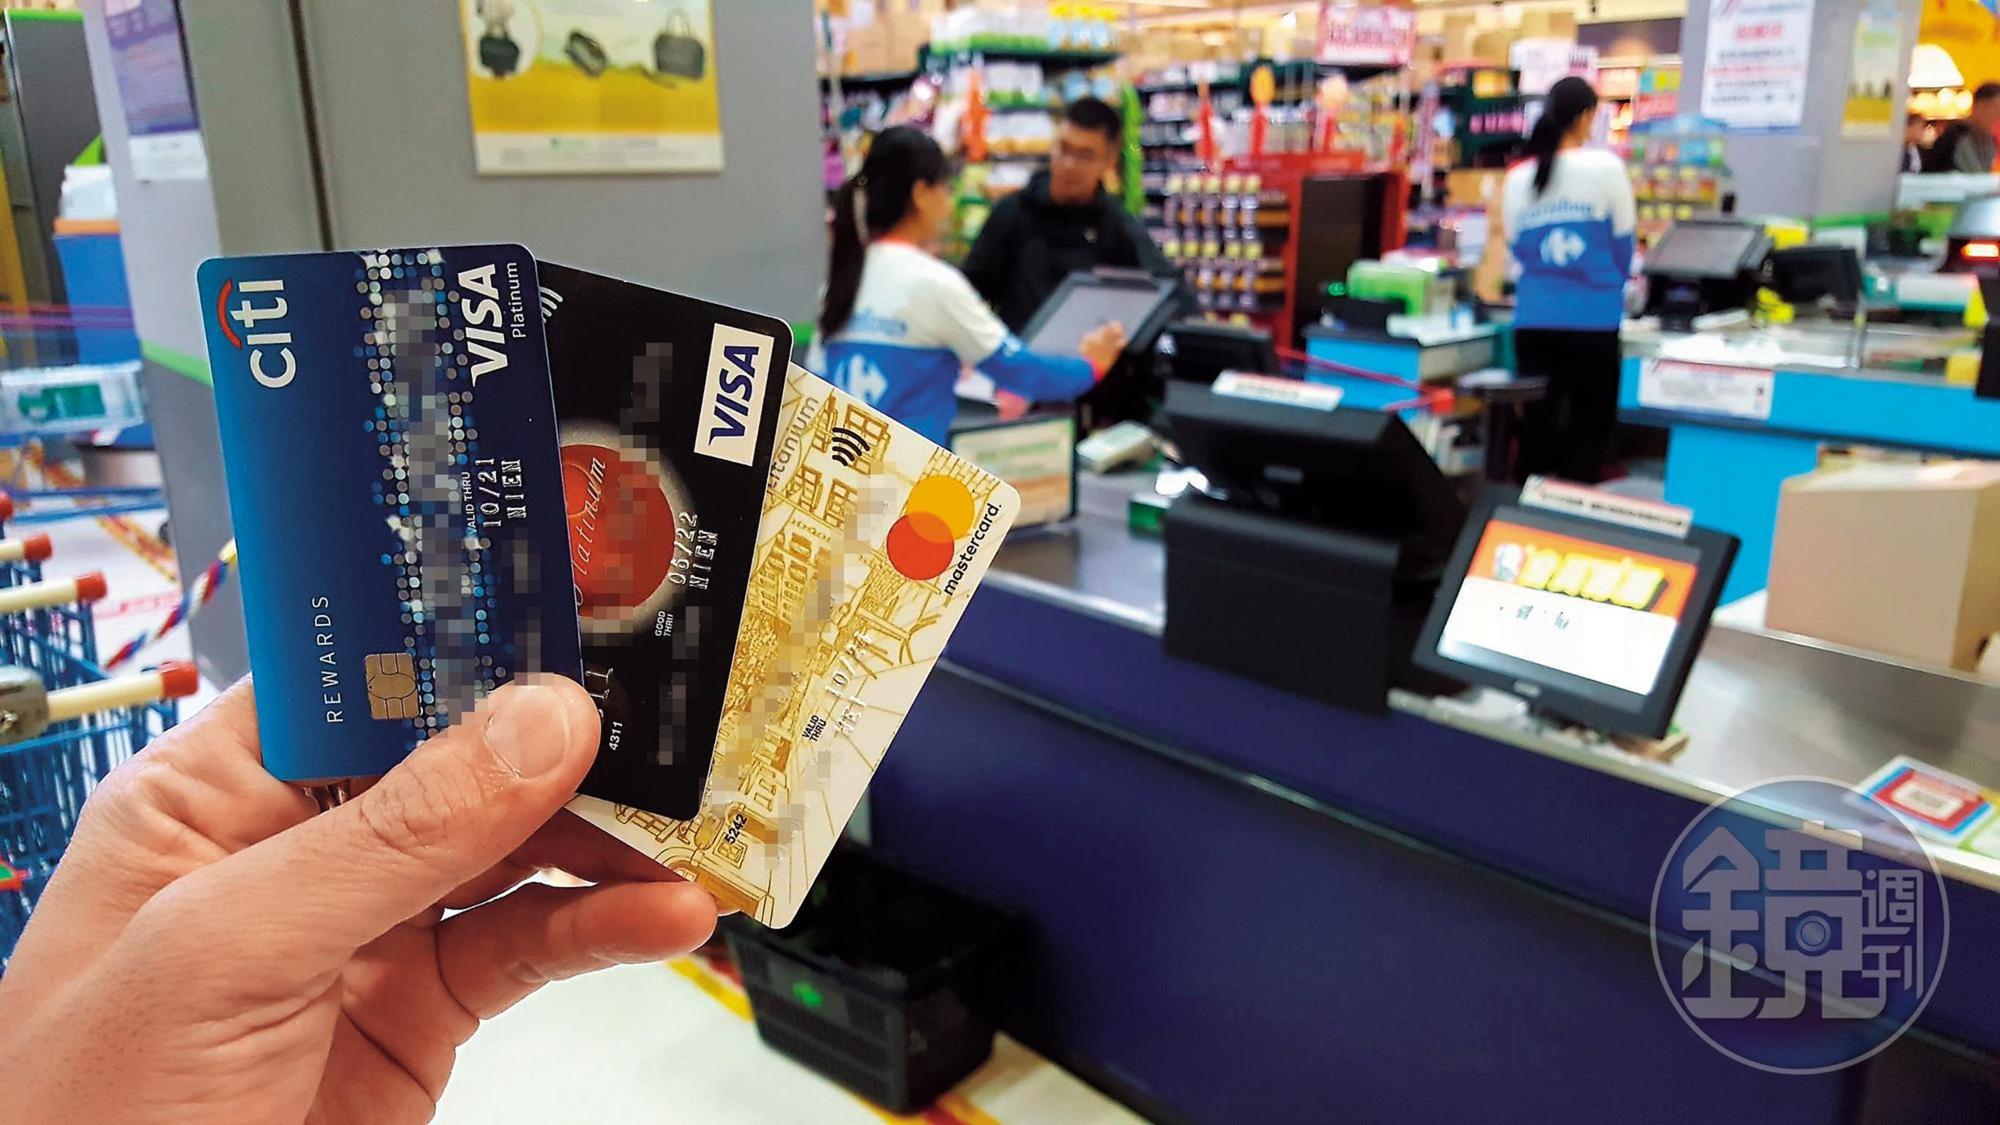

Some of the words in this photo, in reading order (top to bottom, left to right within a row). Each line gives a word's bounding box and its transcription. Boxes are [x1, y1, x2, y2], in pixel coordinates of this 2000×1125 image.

[505, 262, 527, 339] Platinum
[229, 279, 297, 389] citi
[457, 263, 509, 388] VISA
[708, 344, 760, 446] VISA
[461, 471, 473, 502] THRU
[475, 458, 502, 528] 10/21
[501, 459, 527, 519] NIEN
[465, 503, 478, 535] VALID
[654, 610, 667, 637] GOOD
[663, 613, 674, 637] THRU
[312, 596, 344, 724] REWARDS
[608, 721, 623, 751] 4311
[802, 714, 820, 738] VALID
[809, 718, 827, 742] THRU
[724, 813, 748, 845] 5242
